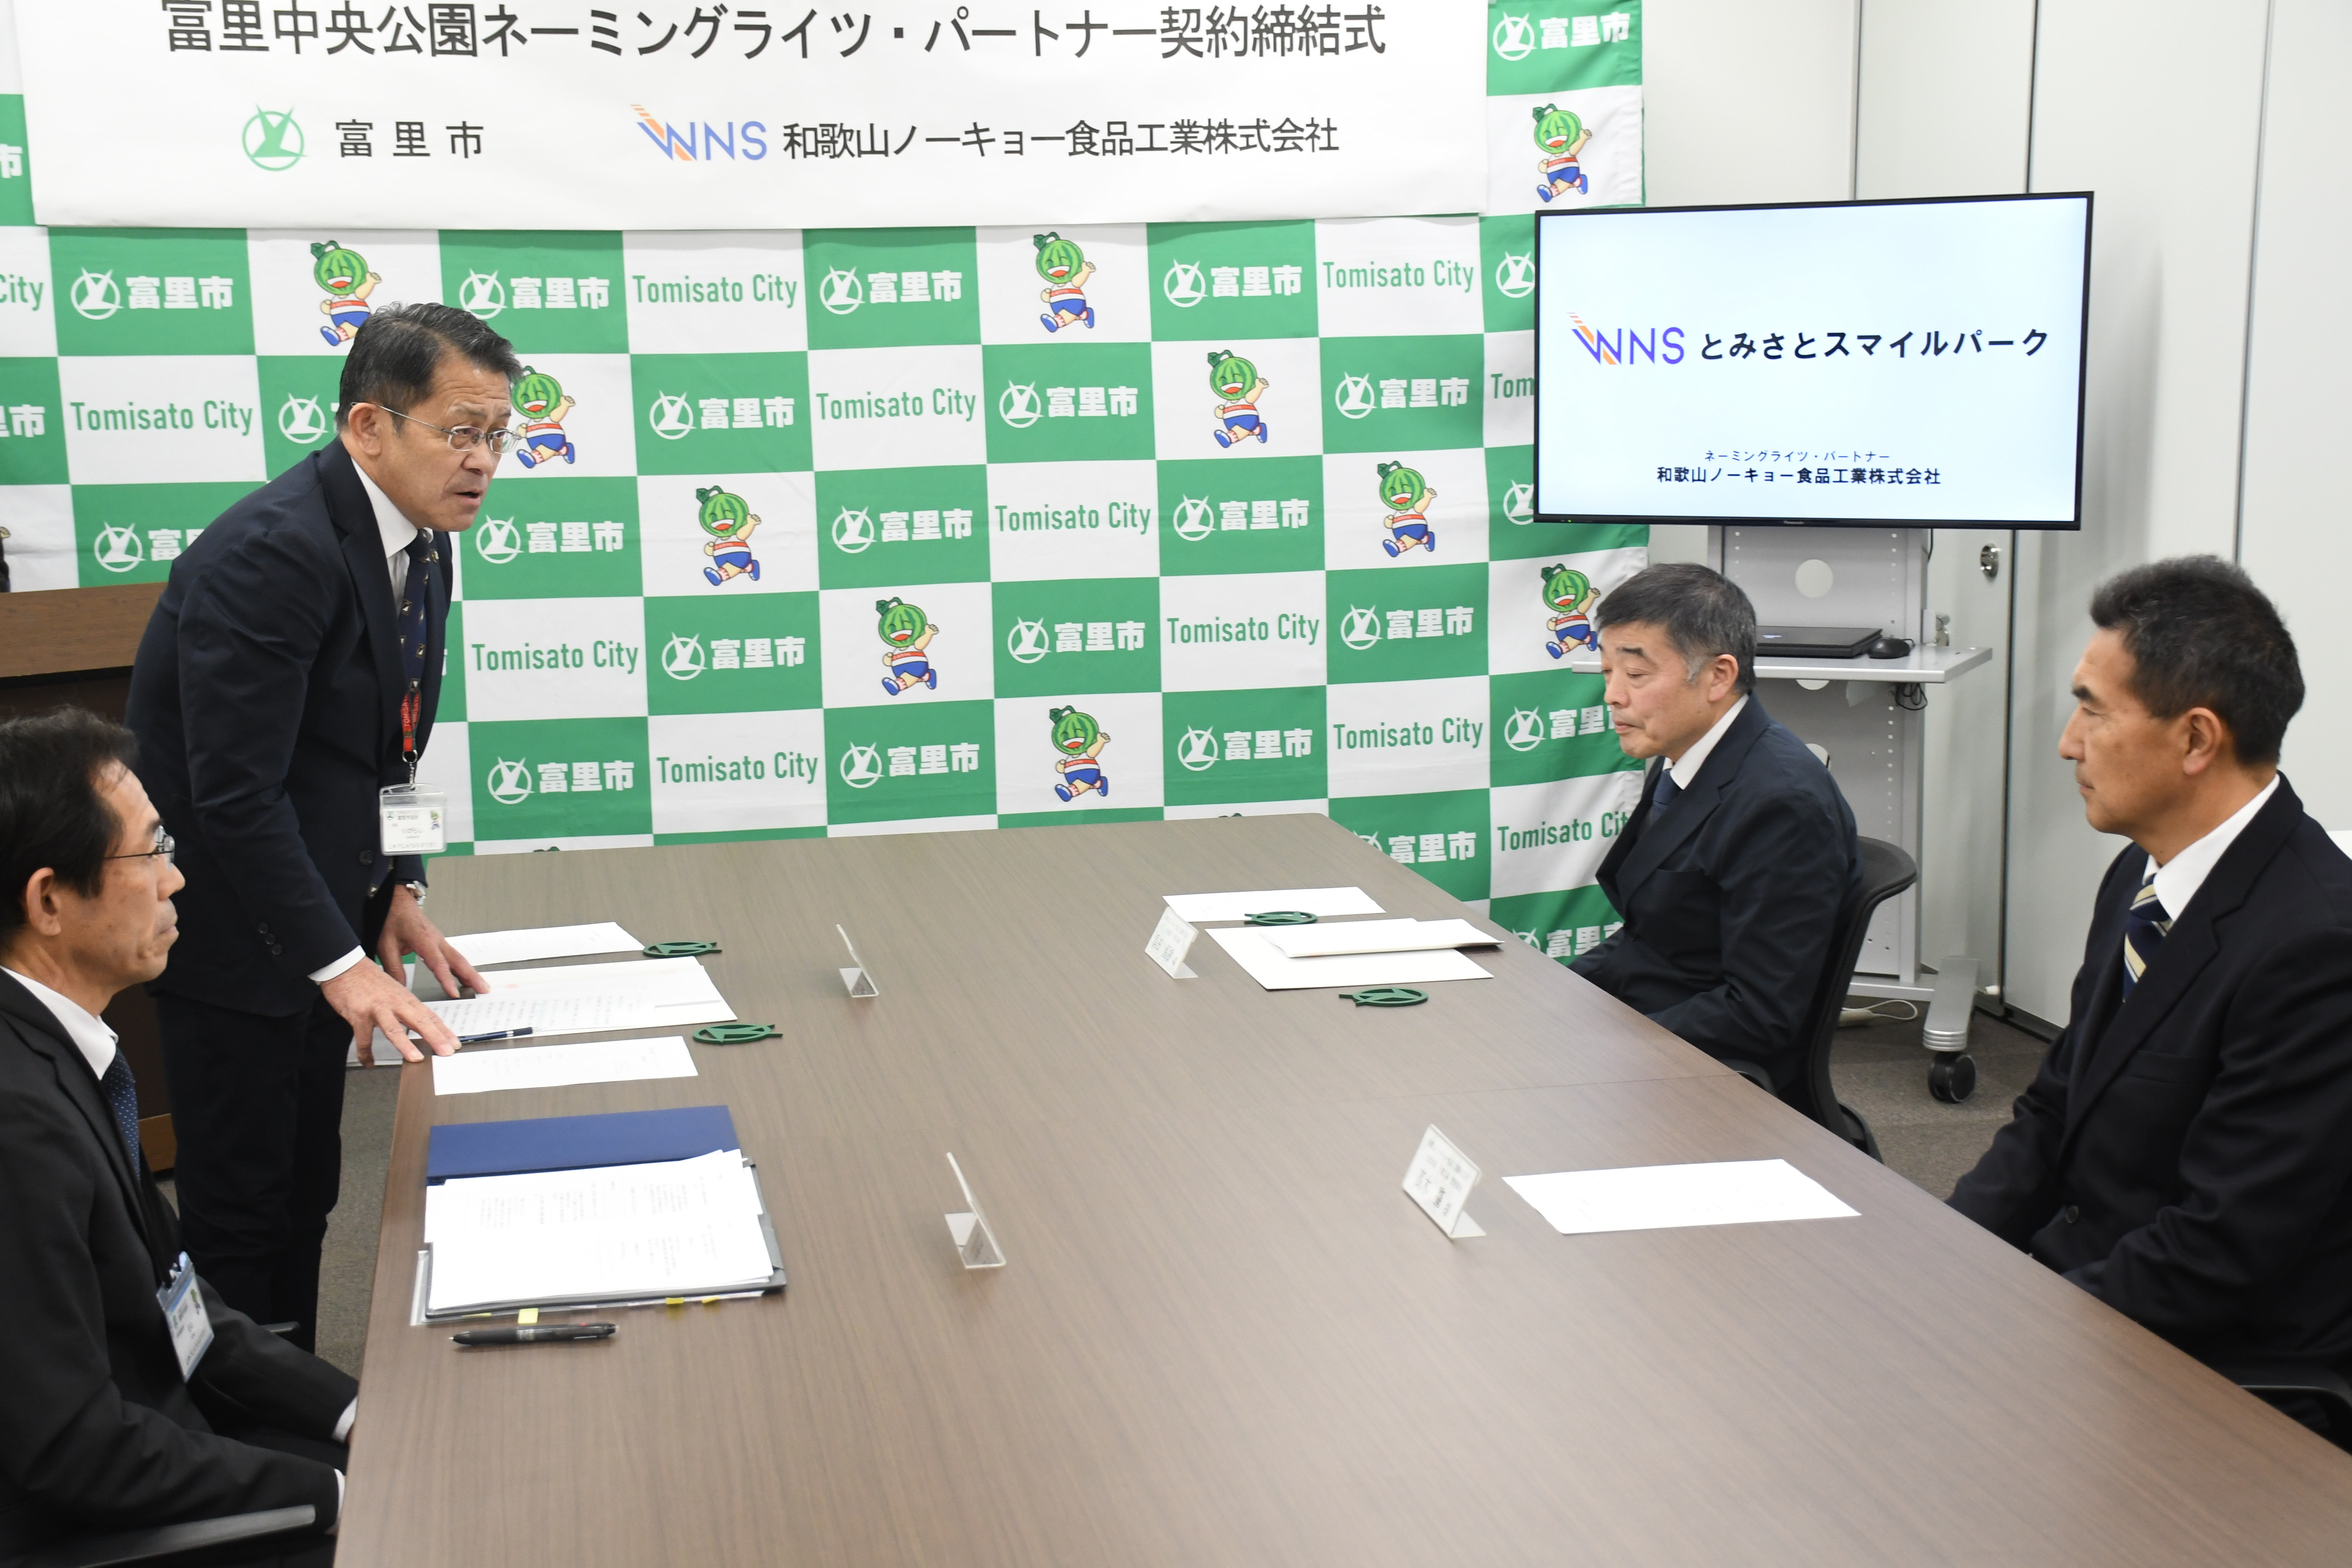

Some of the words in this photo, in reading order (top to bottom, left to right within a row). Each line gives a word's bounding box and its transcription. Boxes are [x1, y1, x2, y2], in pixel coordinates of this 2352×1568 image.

[162, 0, 1385, 59] 富里中央公園ネーミングライツ・パートナー契約締結式
[1540, 12, 1630, 49] 富里市
[631, 104, 767, 161] WNS
[784, 117, 1339, 159] 和歌山ノーキョー食品工業株式会社
[126, 276, 233, 309] 富里市
[511, 277, 609, 309] 富里市
[632, 275, 743, 302] Tomisato
[753, 274, 797, 308] City
[868, 270, 962, 303] 富里市
[1211, 265, 1302, 297] 富里市
[1323, 261, 1424, 288] Tomisato
[1434, 260, 1473, 293] City
[1567, 313, 1685, 365] WNS
[1702, 329, 2047, 359] とみさとスマイルパーク
[816, 392, 923, 419] Tomisato
[933, 388, 976, 422] City
[1047, 386, 1138, 417] 富里市
[1380, 377, 1469, 408] 富里市
[70, 402, 193, 430] Tomisato
[204, 400, 252, 436] City
[699, 397, 794, 429] 富里市
[1658, 467, 1940, 484] 和歌山ノーキョー食品工業株式会社
[880, 509, 972, 542] 富里市
[995, 504, 1099, 531] Tomisato
[1109, 502, 1150, 535] City
[1220, 499, 1309, 531] 富里市
[526, 521, 623, 553] 富里市
[1055, 621, 1145, 652] 富里市
[1167, 617, 1269, 643] Tomisato
[1278, 614, 1319, 645] City
[1386, 606, 1473, 639] 富里市
[472, 643, 583, 670] Tomisato
[593, 640, 638, 674] City
[711, 636, 805, 669] 富里市
[1224, 728, 1312, 760] 富里市
[1334, 722, 1433, 749] Tomisato
[1443, 718, 1483, 748] City
[657, 756, 765, 783] Tomisato
[774, 752, 817, 784] City
[888, 743, 979, 776] 富里市
[538, 760, 634, 793] 富里市
[1388, 831, 1476, 863] 富里市
[1498, 819, 1592, 851] Tomisato
[1602, 811, 1628, 838] Cit
